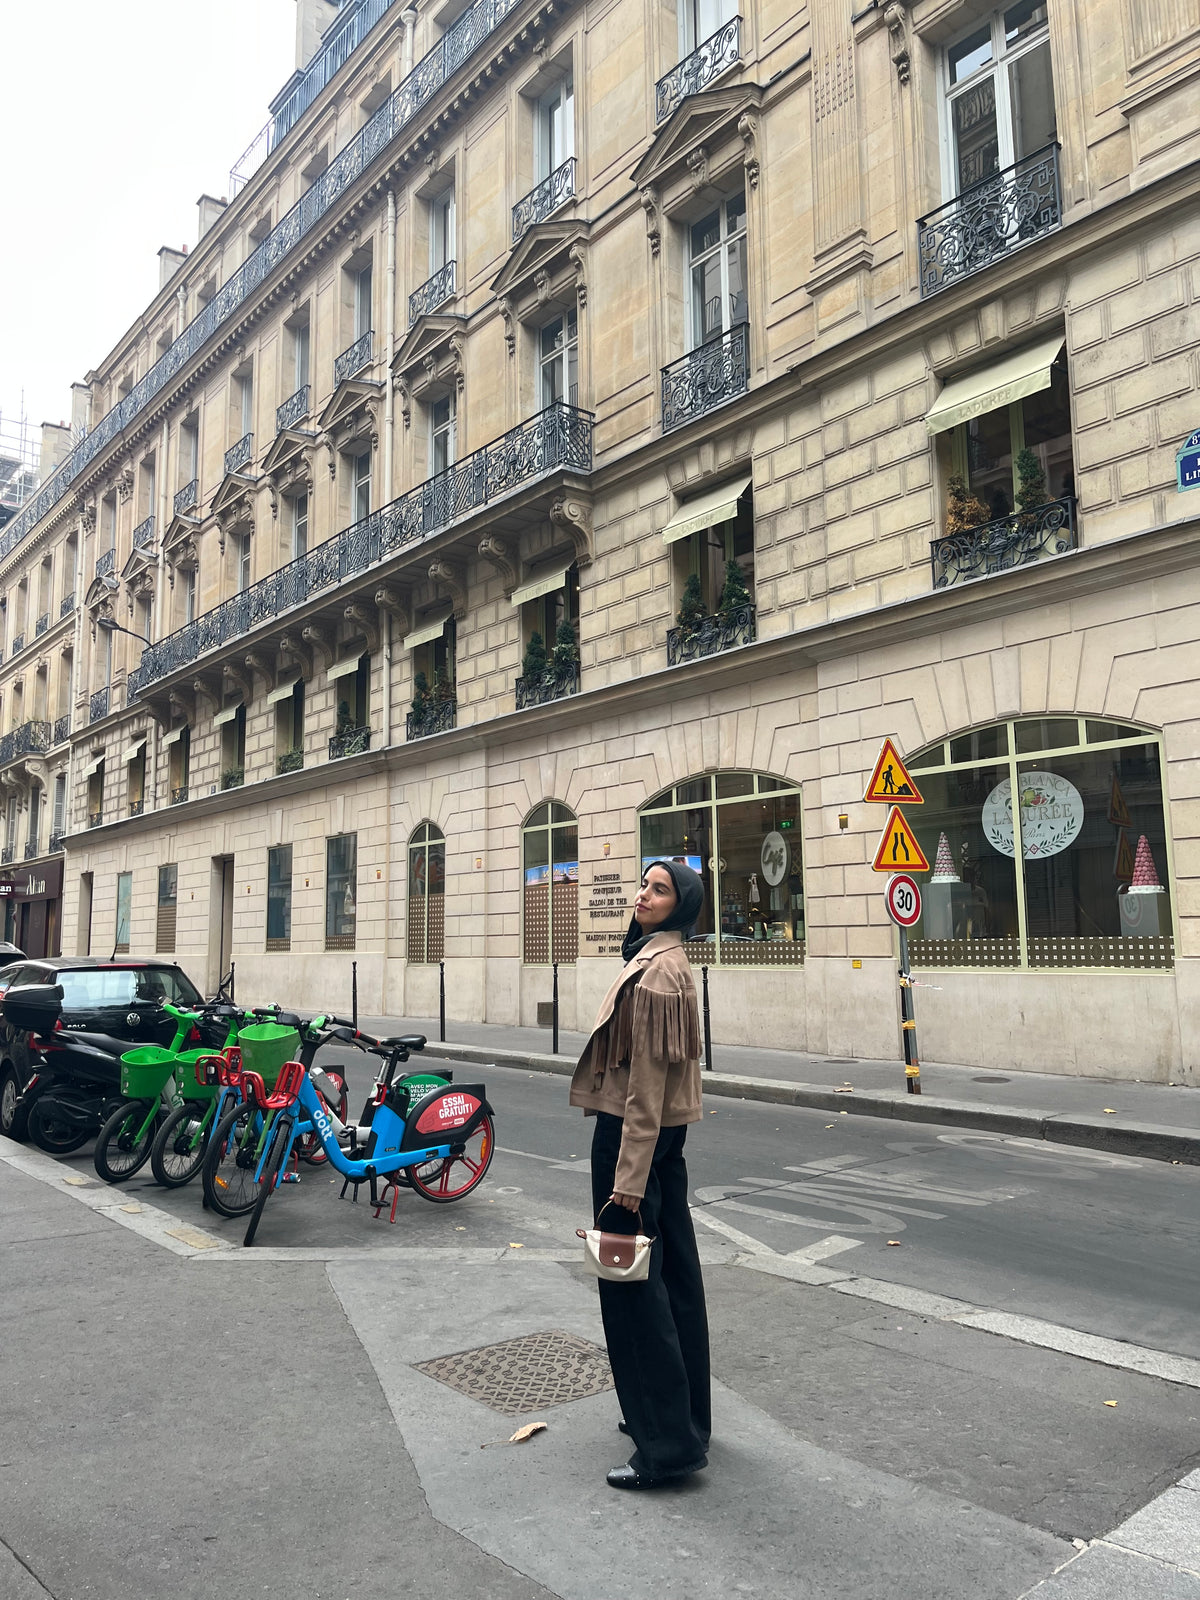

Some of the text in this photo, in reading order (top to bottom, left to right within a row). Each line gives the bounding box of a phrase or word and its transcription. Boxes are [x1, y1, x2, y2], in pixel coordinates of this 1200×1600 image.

[990, 775, 1071, 805] CASBLANCA
[896, 888, 913, 912] 30
[589, 909, 625, 918] RESTAURANT
[442, 1095, 465, 1108] ESSAI
[313, 1109, 333, 1142] dott
